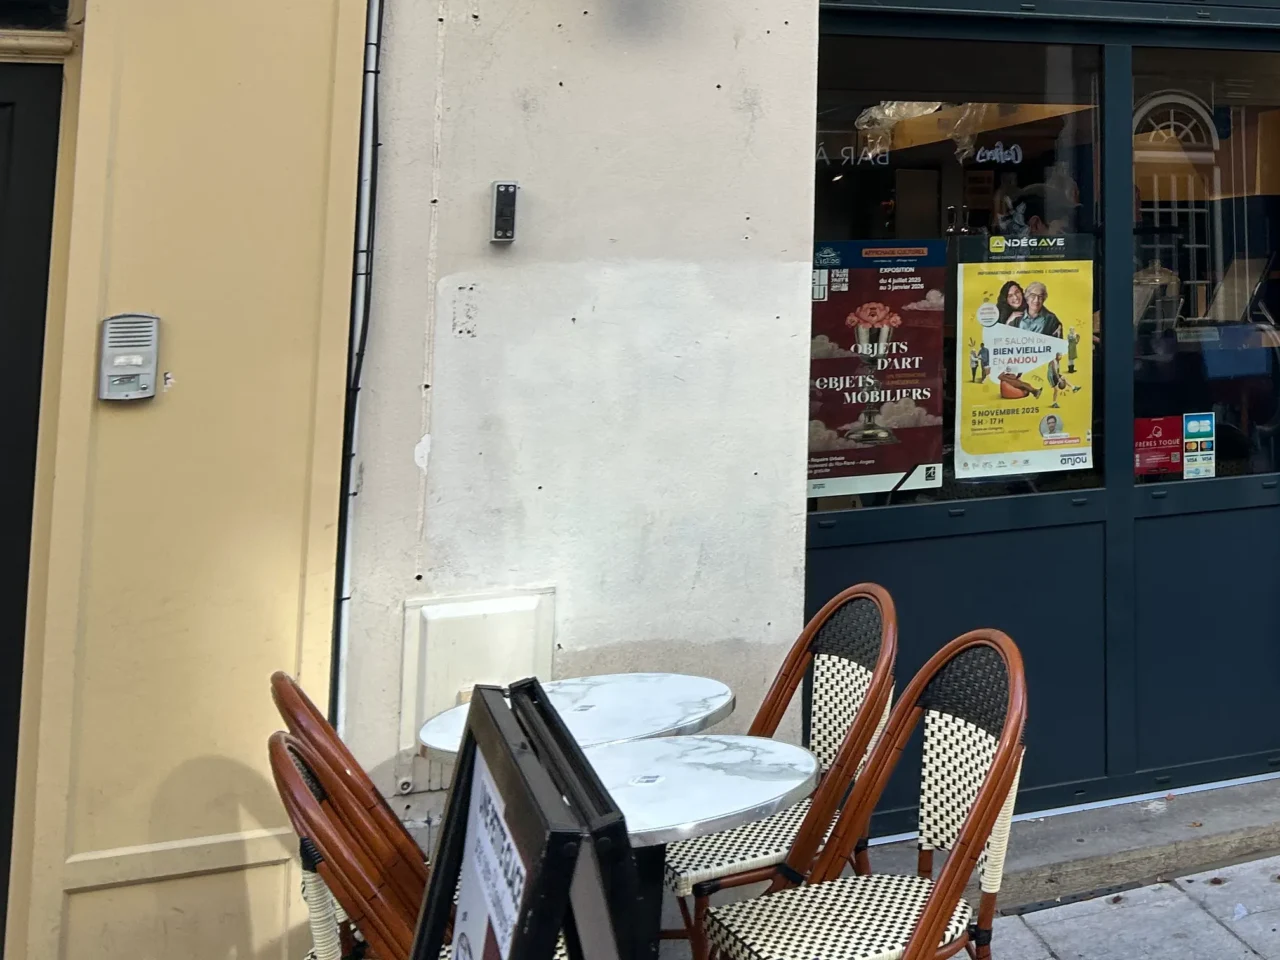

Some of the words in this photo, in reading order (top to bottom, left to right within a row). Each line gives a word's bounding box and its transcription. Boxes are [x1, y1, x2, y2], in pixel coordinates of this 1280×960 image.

[1005, 337, 1035, 346] SALON
[849, 341, 908, 358] OBJETS
[993, 347, 1014, 356] BIEN
[1015, 345, 1052, 355] VIEILLIR
[992, 357, 1005, 366] EN
[1006, 356, 1038, 365] ANJOU
[815, 374, 875, 391] OBJETS
[842, 387, 932, 405] MOBILIERS
[978, 408, 1020, 417] NOVEMBRE
[1021, 406, 1040, 414] 2025
[1060, 456, 1088, 466] anjou
